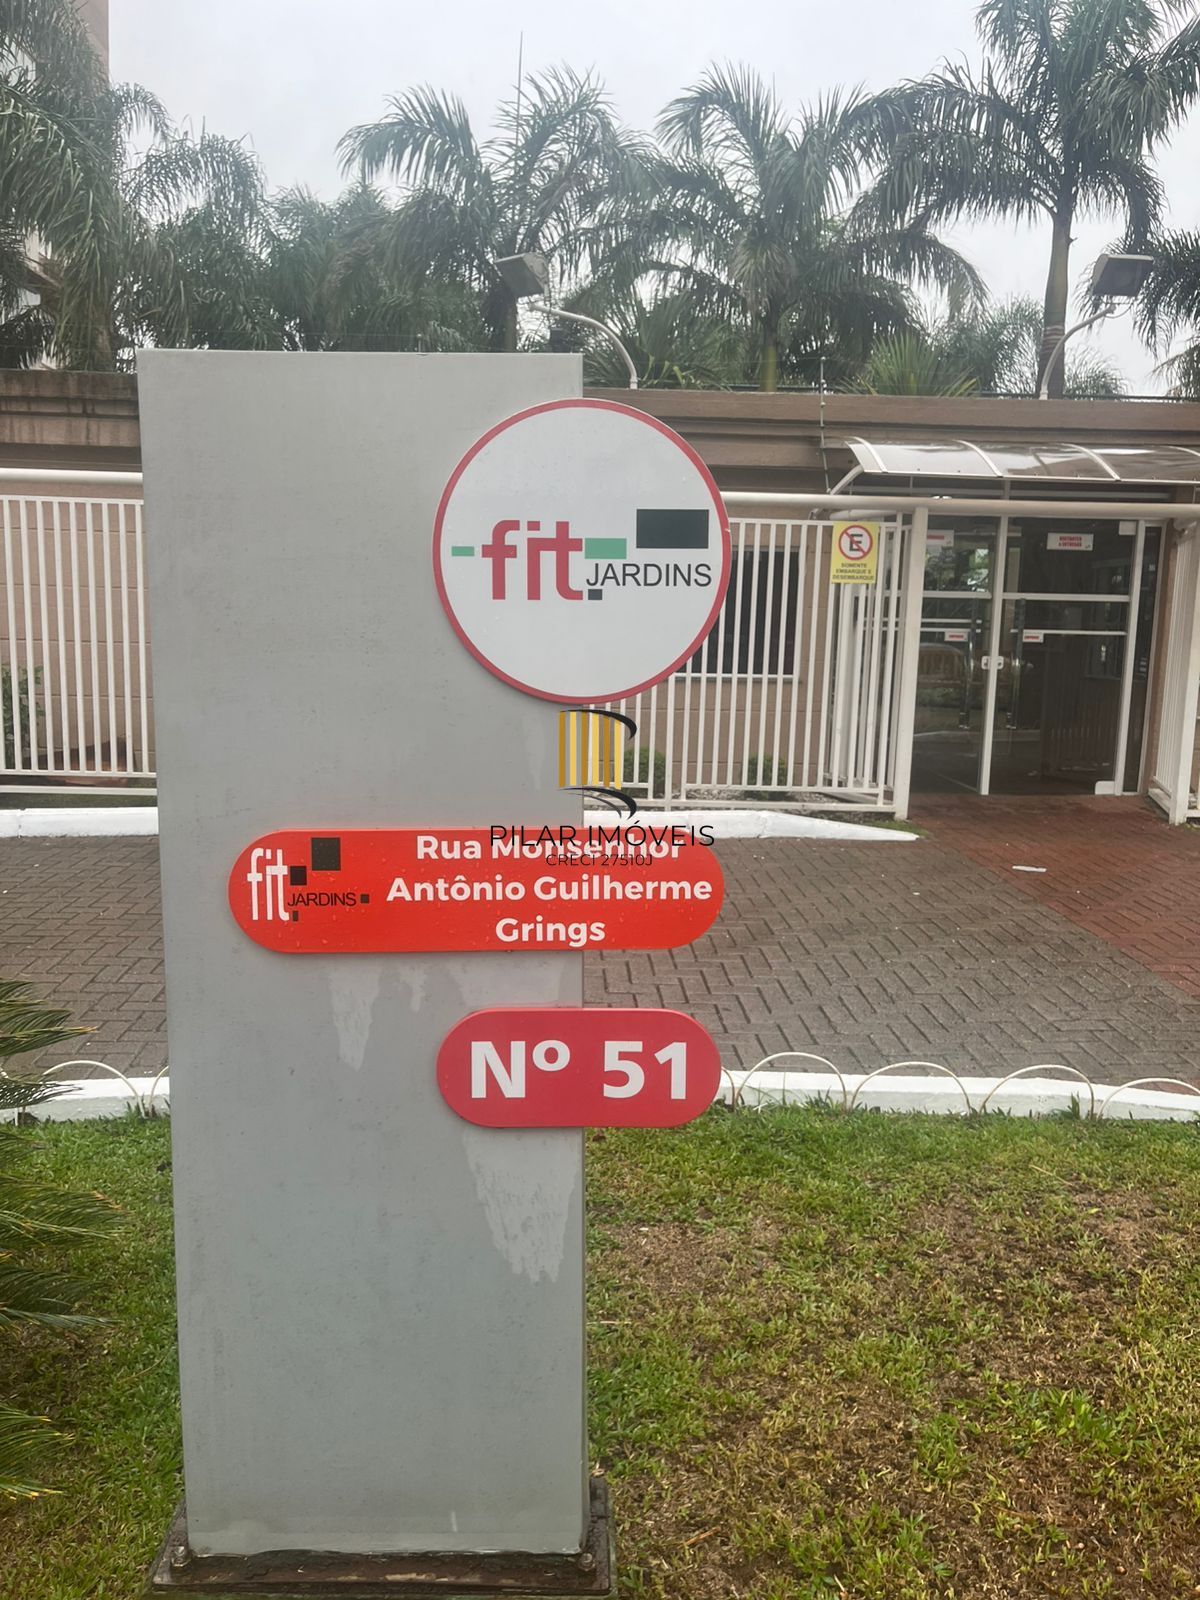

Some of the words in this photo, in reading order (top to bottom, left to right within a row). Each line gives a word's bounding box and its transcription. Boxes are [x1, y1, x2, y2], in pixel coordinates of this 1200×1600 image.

[481, 520, 584, 600] fit
[586, 563, 712, 587] JARDINS
[416, 835, 482, 859] Rua
[492, 833, 685, 859] Monsenhor
[247, 848, 290, 921] fit
[287, 892, 357, 906] JARDINS
[386, 874, 526, 901] Antônio
[533, 874, 713, 901] Guilherme
[495, 915, 606, 947] Grings
[603, 1041, 687, 1099] 51
